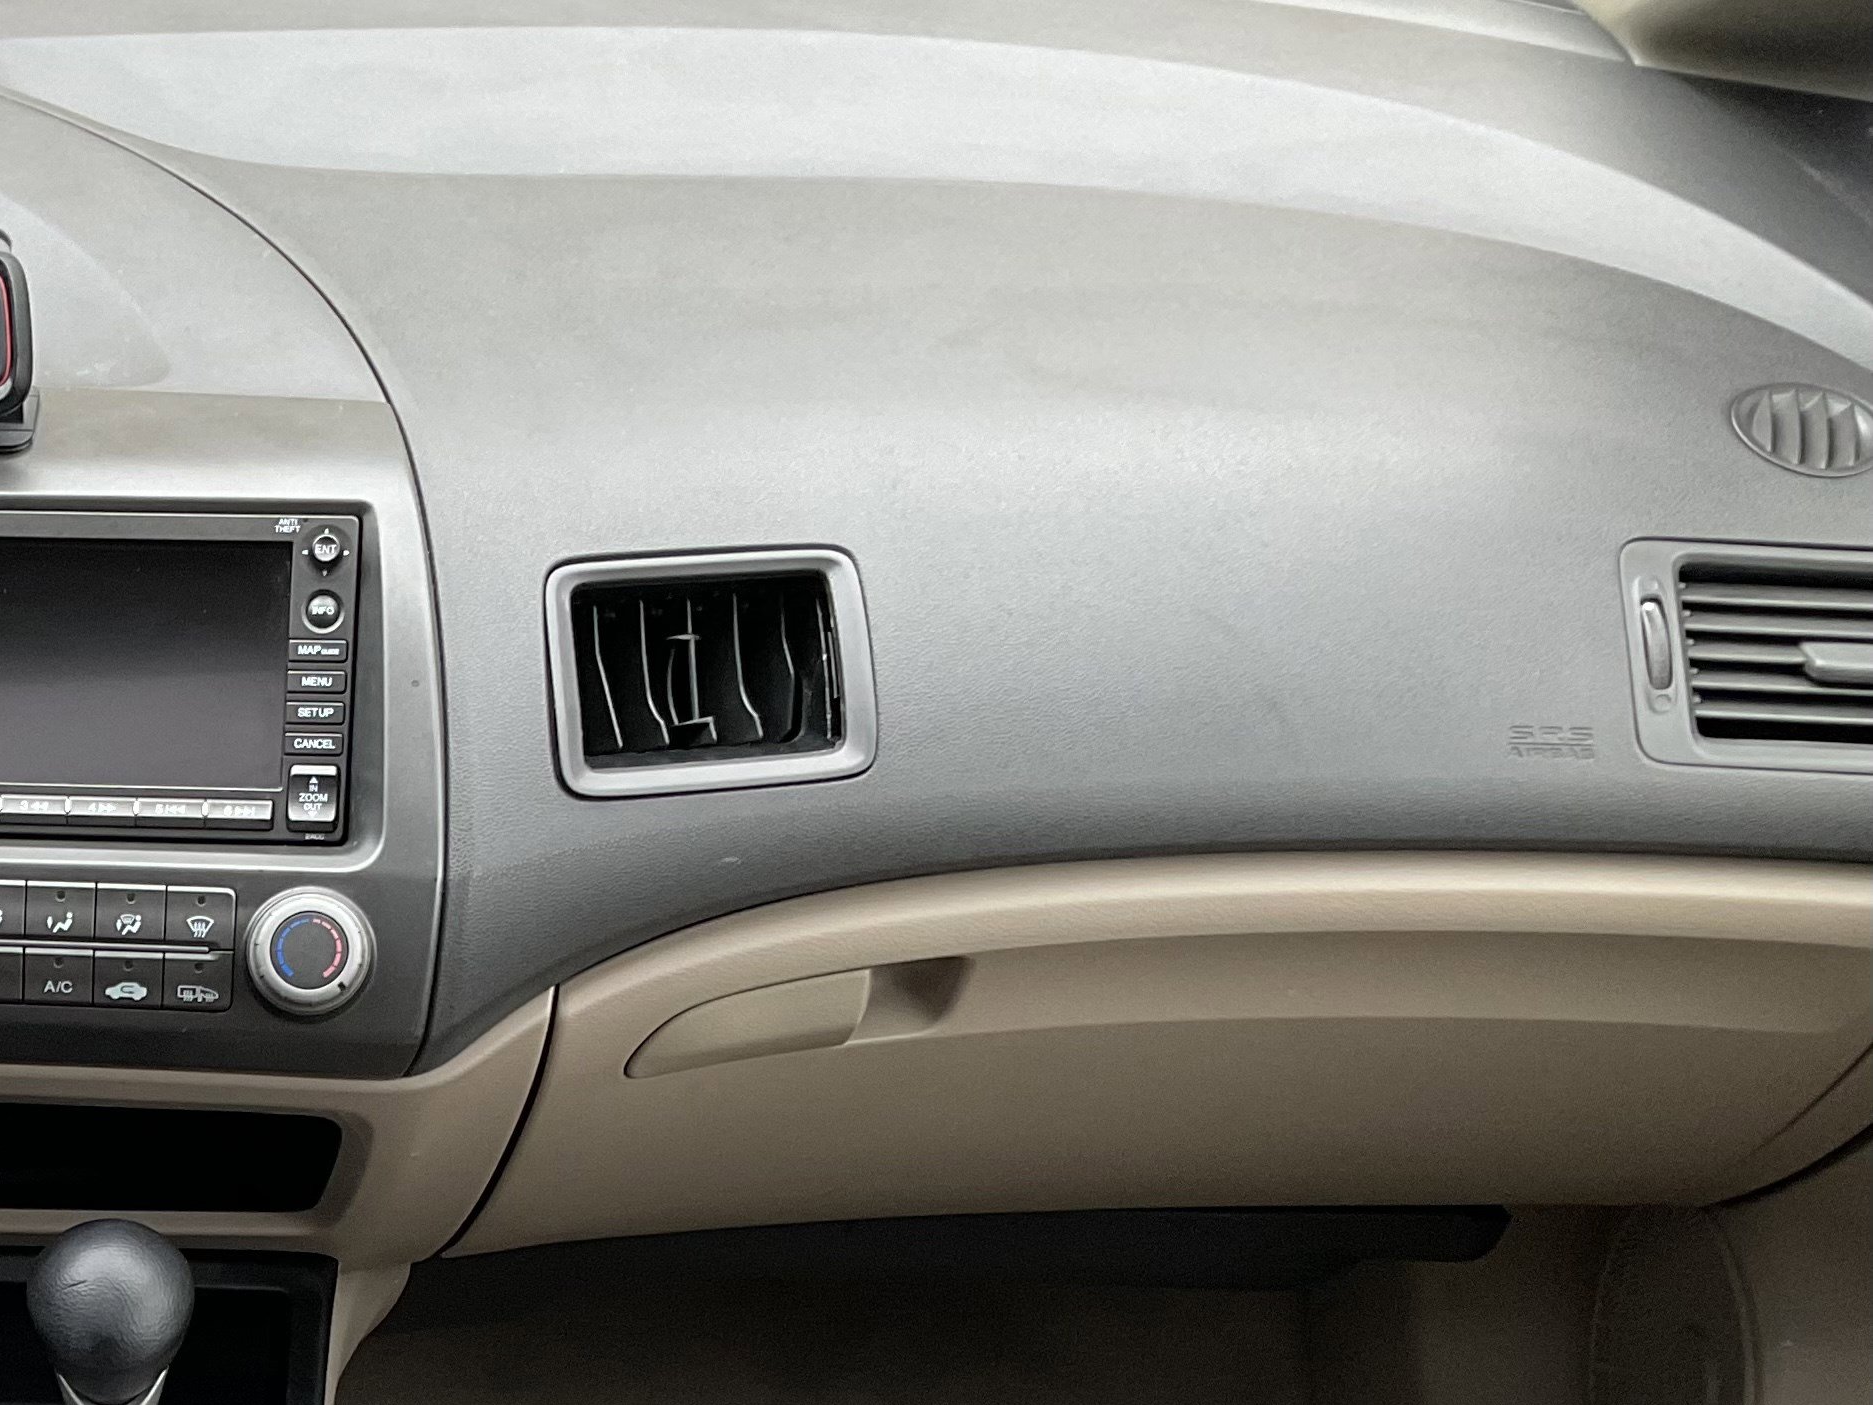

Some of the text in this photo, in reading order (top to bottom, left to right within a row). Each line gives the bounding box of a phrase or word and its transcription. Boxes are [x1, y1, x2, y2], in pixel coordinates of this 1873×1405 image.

[278, 518, 299, 526] ANTI
[274, 525, 301, 533] THEFT
[314, 543, 337, 554] ENT
[297, 645, 322, 655] MAP
[301, 676, 333, 687] MENU
[293, 738, 336, 749] CANCEL
[298, 792, 329, 802] ZOOM
[303, 803, 323, 811] OUT
[43, 981, 73, 994] A/C
